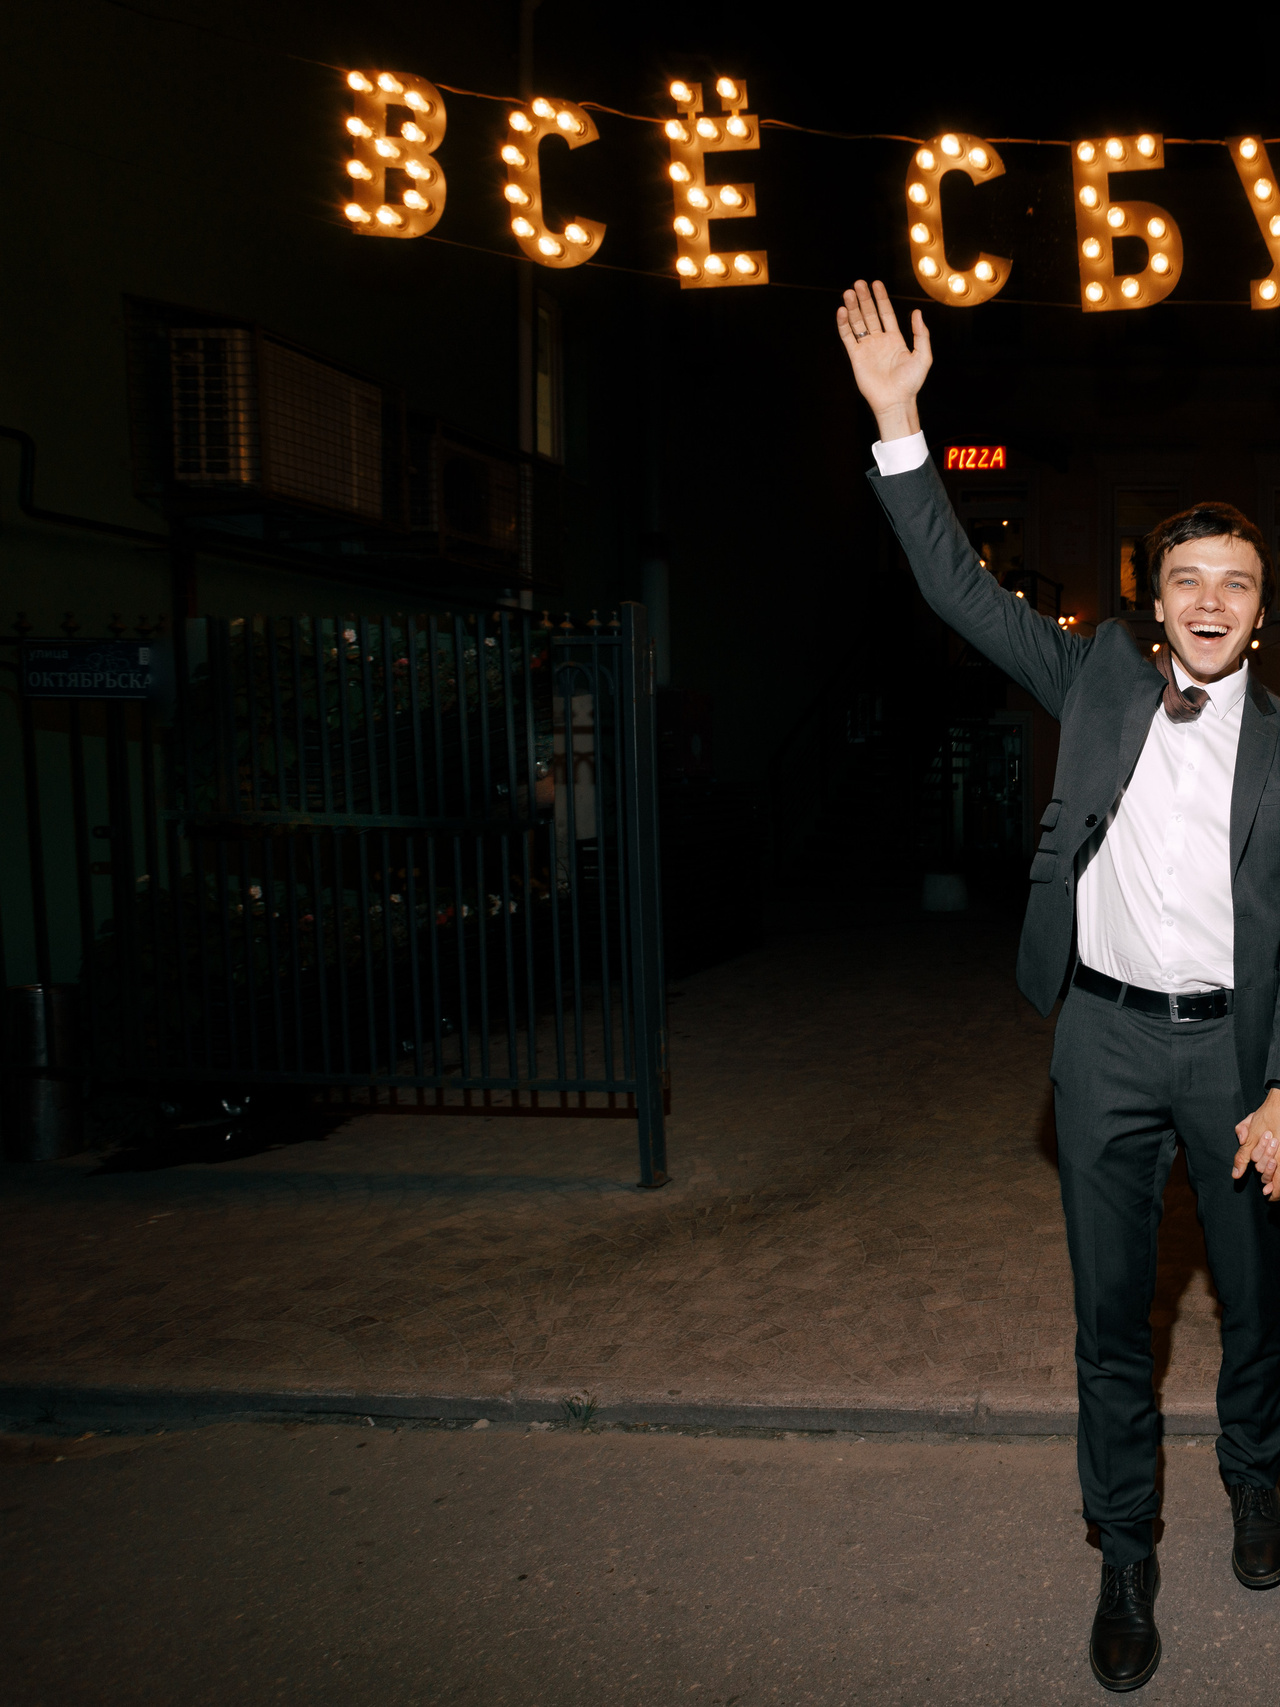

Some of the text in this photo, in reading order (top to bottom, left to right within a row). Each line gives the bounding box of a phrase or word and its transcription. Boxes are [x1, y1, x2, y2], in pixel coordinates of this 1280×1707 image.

[346, 69, 769, 289] ВСЁ
[947, 447, 1003, 469] PIZZA
[28, 649, 69, 661] улица
